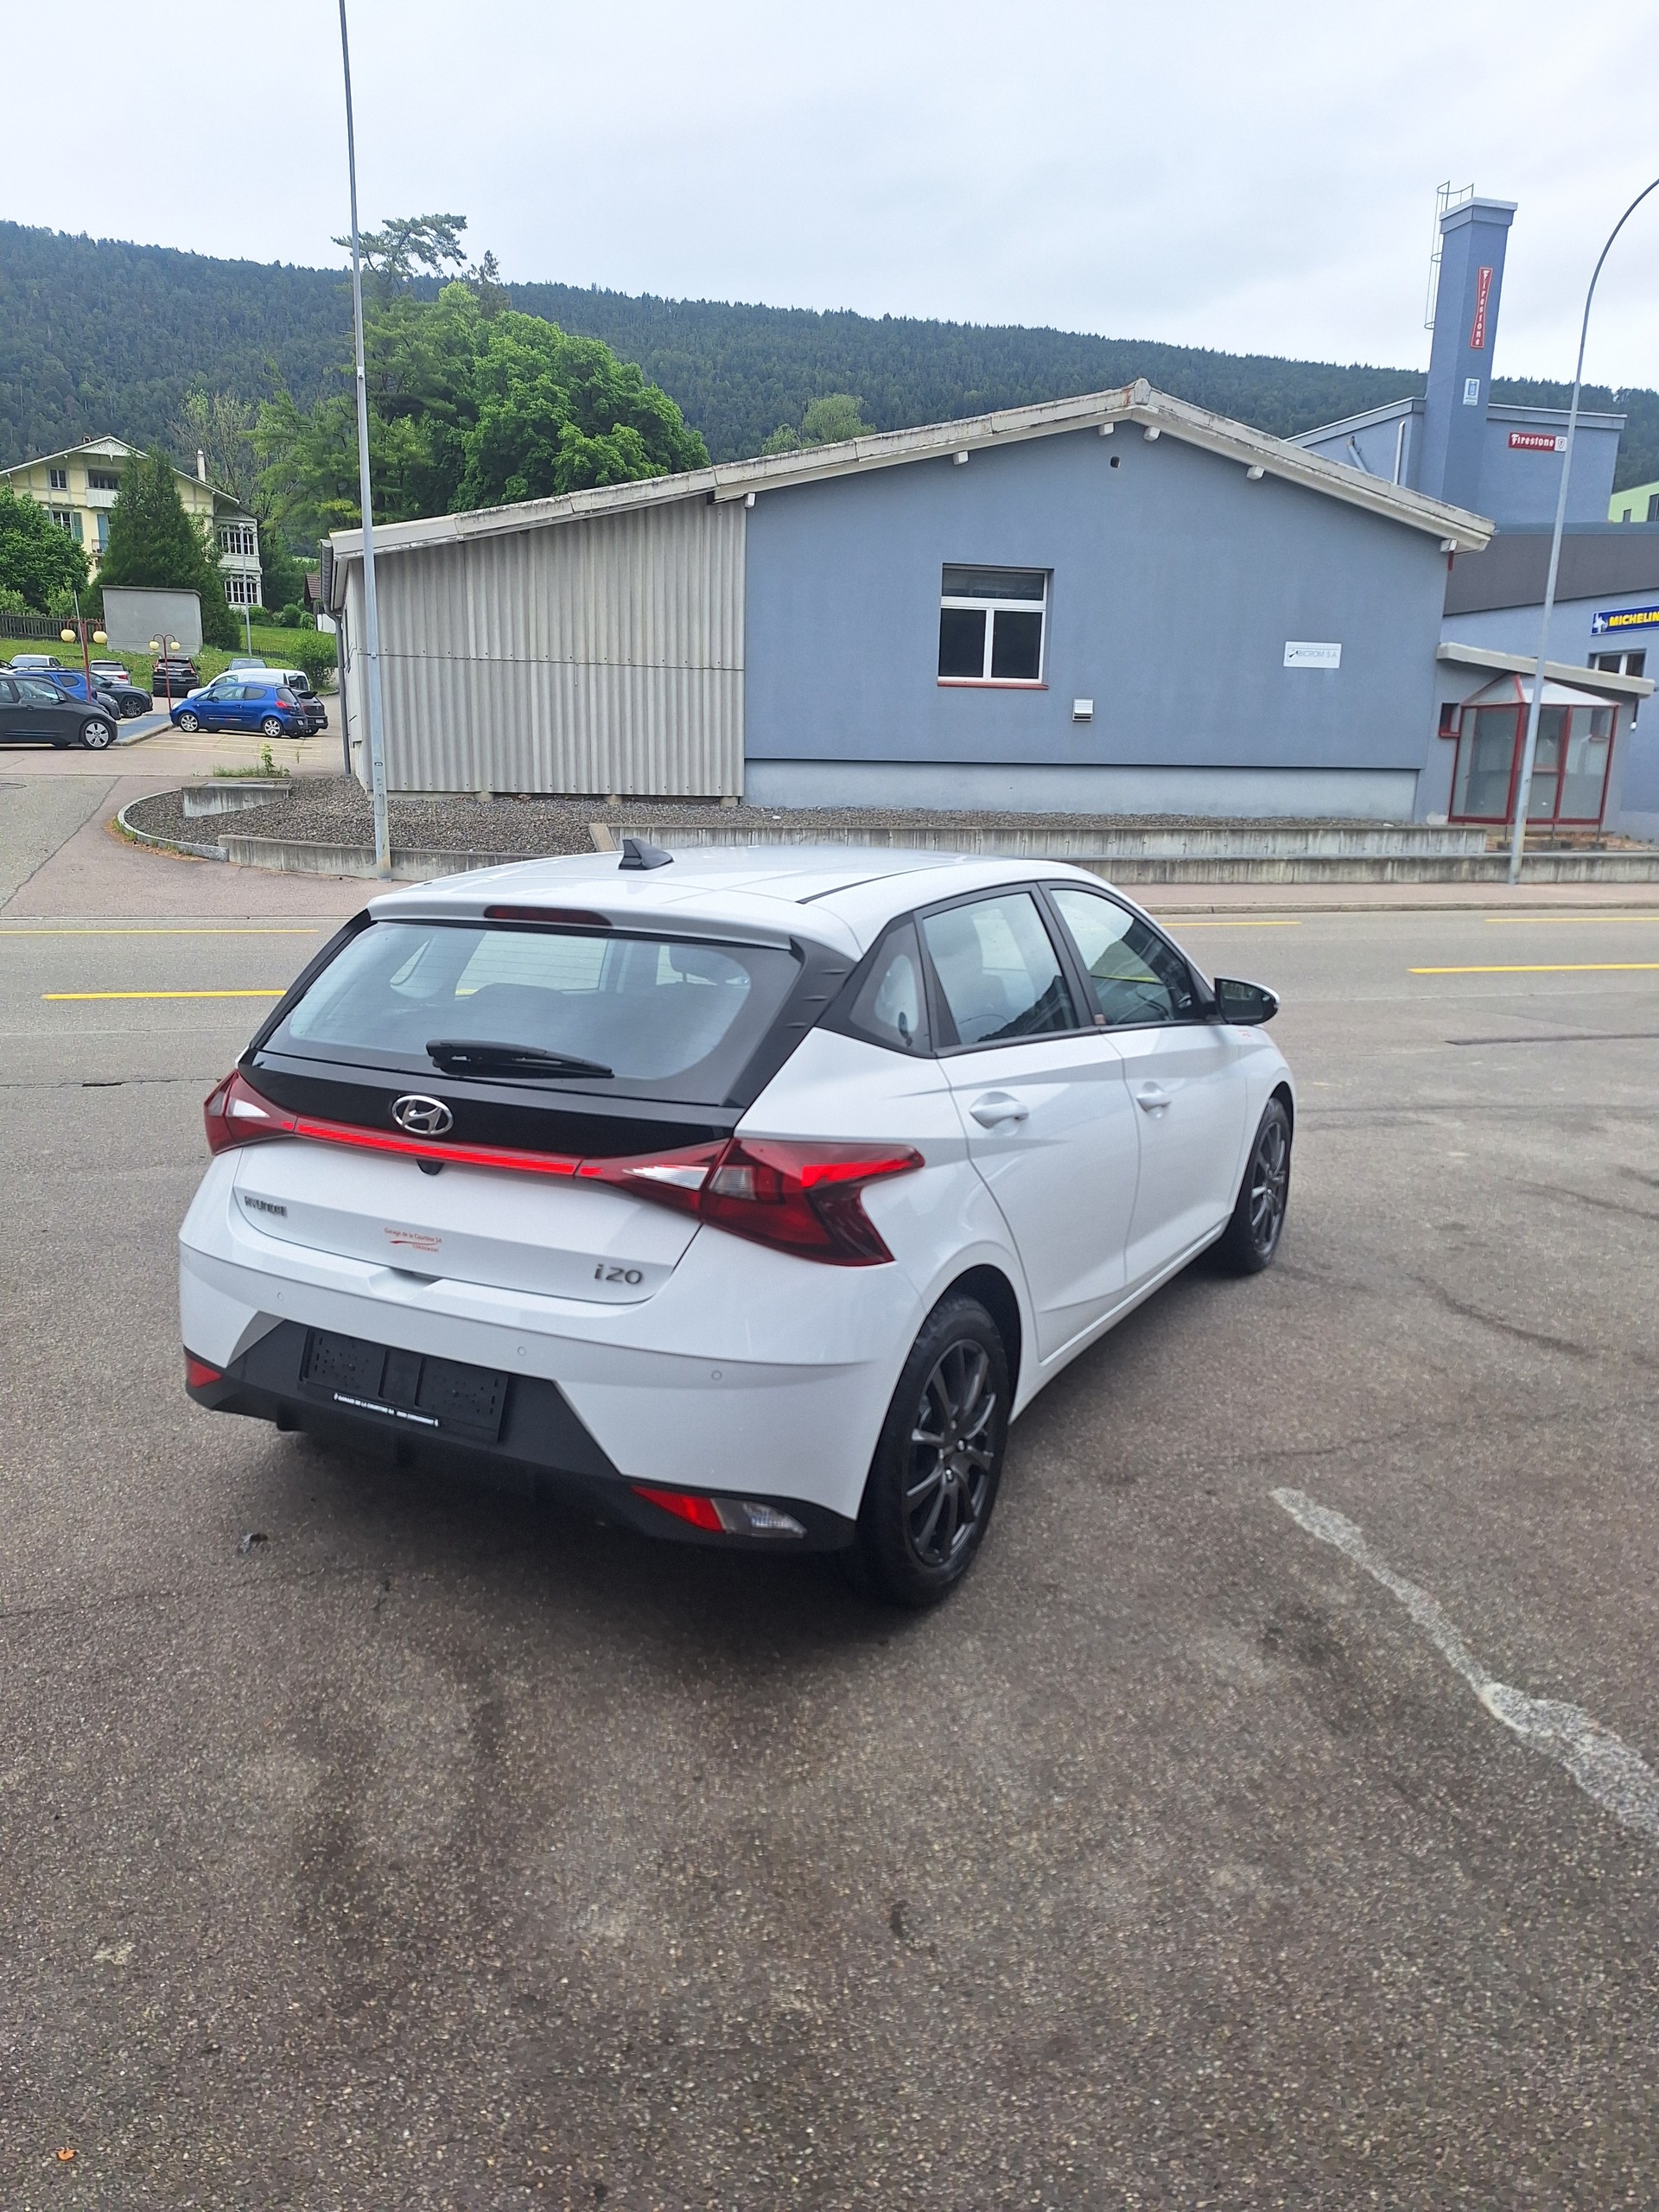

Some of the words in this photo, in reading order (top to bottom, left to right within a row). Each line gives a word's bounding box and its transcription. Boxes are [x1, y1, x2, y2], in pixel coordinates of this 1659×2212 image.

[1475, 270, 1490, 346] Firestone
[1511, 433, 1554, 448] Firestone
[1609, 611, 1659, 626] MICHELIN
[594, 1263, 643, 1285] i20
